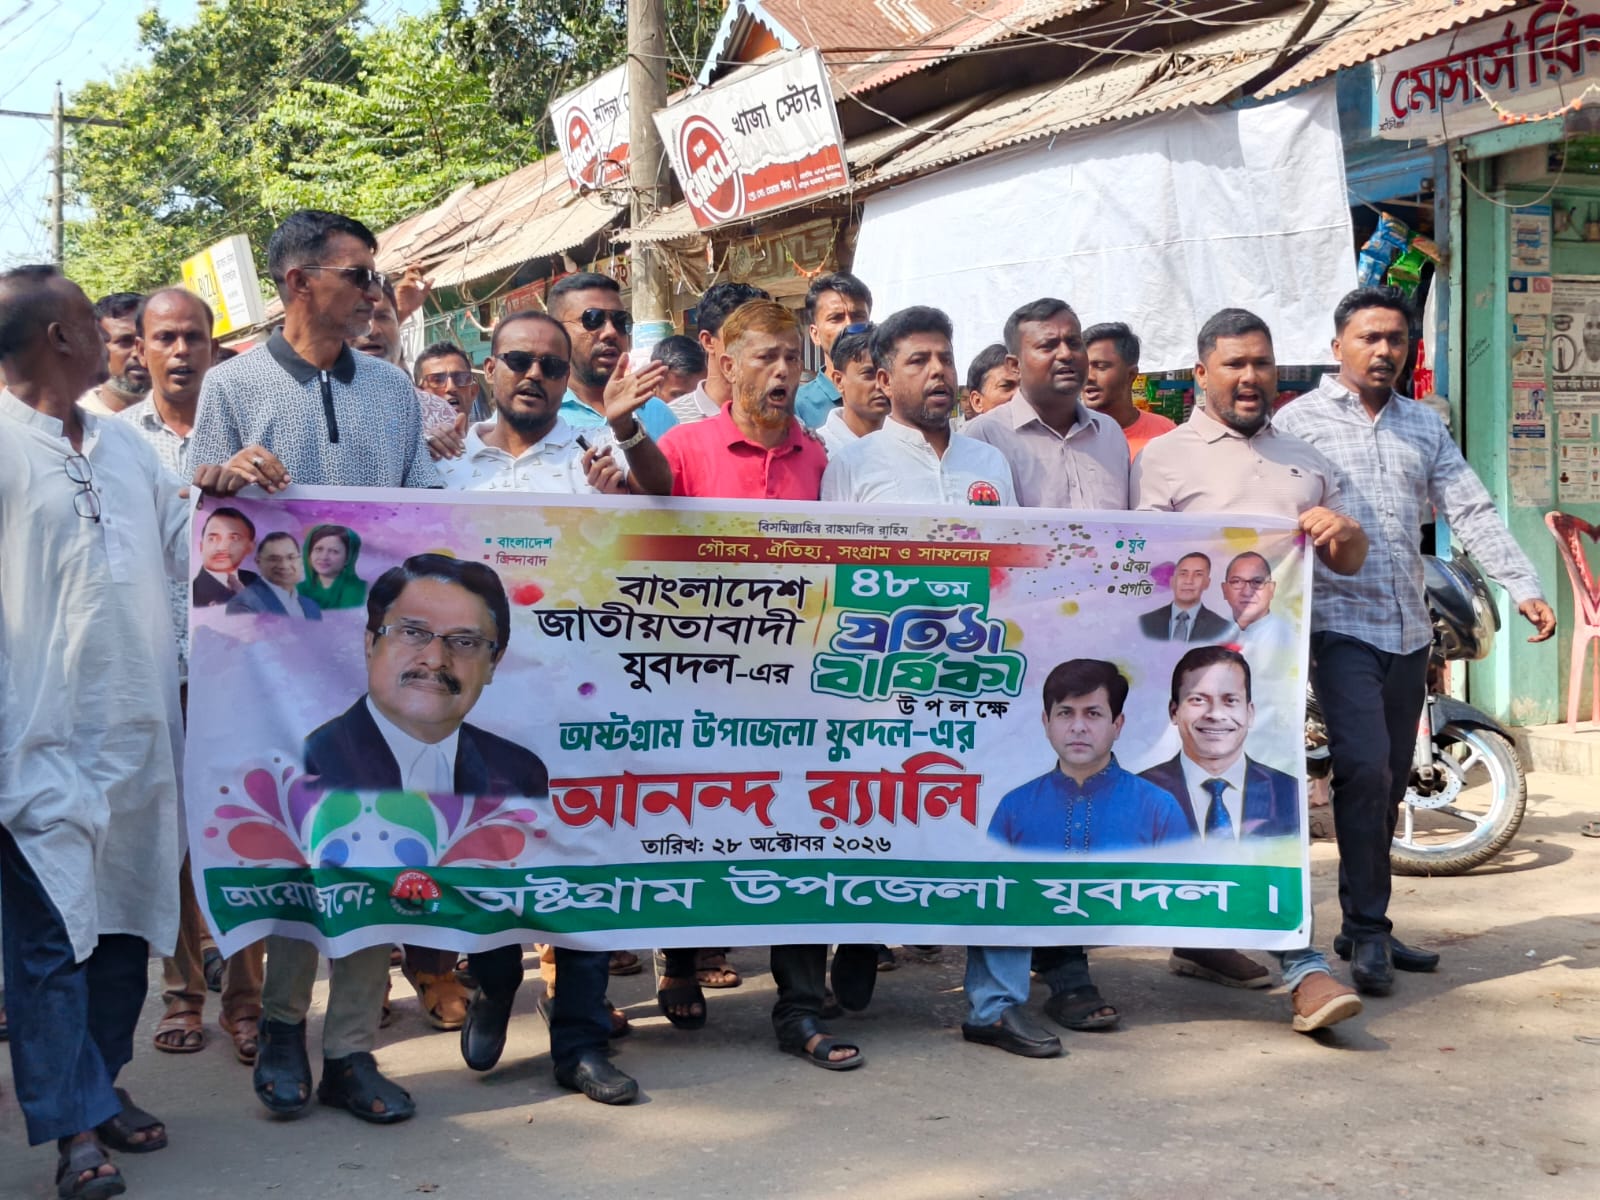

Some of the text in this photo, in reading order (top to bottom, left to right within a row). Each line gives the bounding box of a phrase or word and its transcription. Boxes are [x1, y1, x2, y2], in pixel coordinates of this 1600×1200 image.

[1390, 20, 1521, 119] মেসার্স
[731, 82, 822, 136] খাজা স্টোর
[686, 137, 741, 208] CIRCLE
[496, 536, 552, 549] বাংলাদেশ
[838, 545, 892, 560] সংগ্রাম
[898, 547, 911, 560] ও
[918, 547, 991, 562] সাফল্যের
[1128, 539, 1146, 554] যুব
[850, 568, 971, 599] ৪৮ তম
[1123, 556, 1151, 574] ঐক্য
[616, 573, 813, 609] বাংলাদেশ
[1119, 579, 1153, 596] প্রগতি
[533, 602, 806, 645] জাতীয়তাবাদী
[833, 606, 1003, 654] প্রতিষ্ঠা
[559, 712, 684, 751] অষ্টগ্রাম
[692, 709, 818, 749] উপজেলা
[549, 770, 781, 830] আনন্দ
[712, 838, 742, 855] ২৮
[750, 831, 826, 853] অক্টোবর
[832, 836, 891, 853] ২০২৬
[452, 874, 705, 917] অষ্টগ্রাম
[721, 865, 1018, 911] উপজেলা
[1032, 878, 1240, 918] যুবদল
